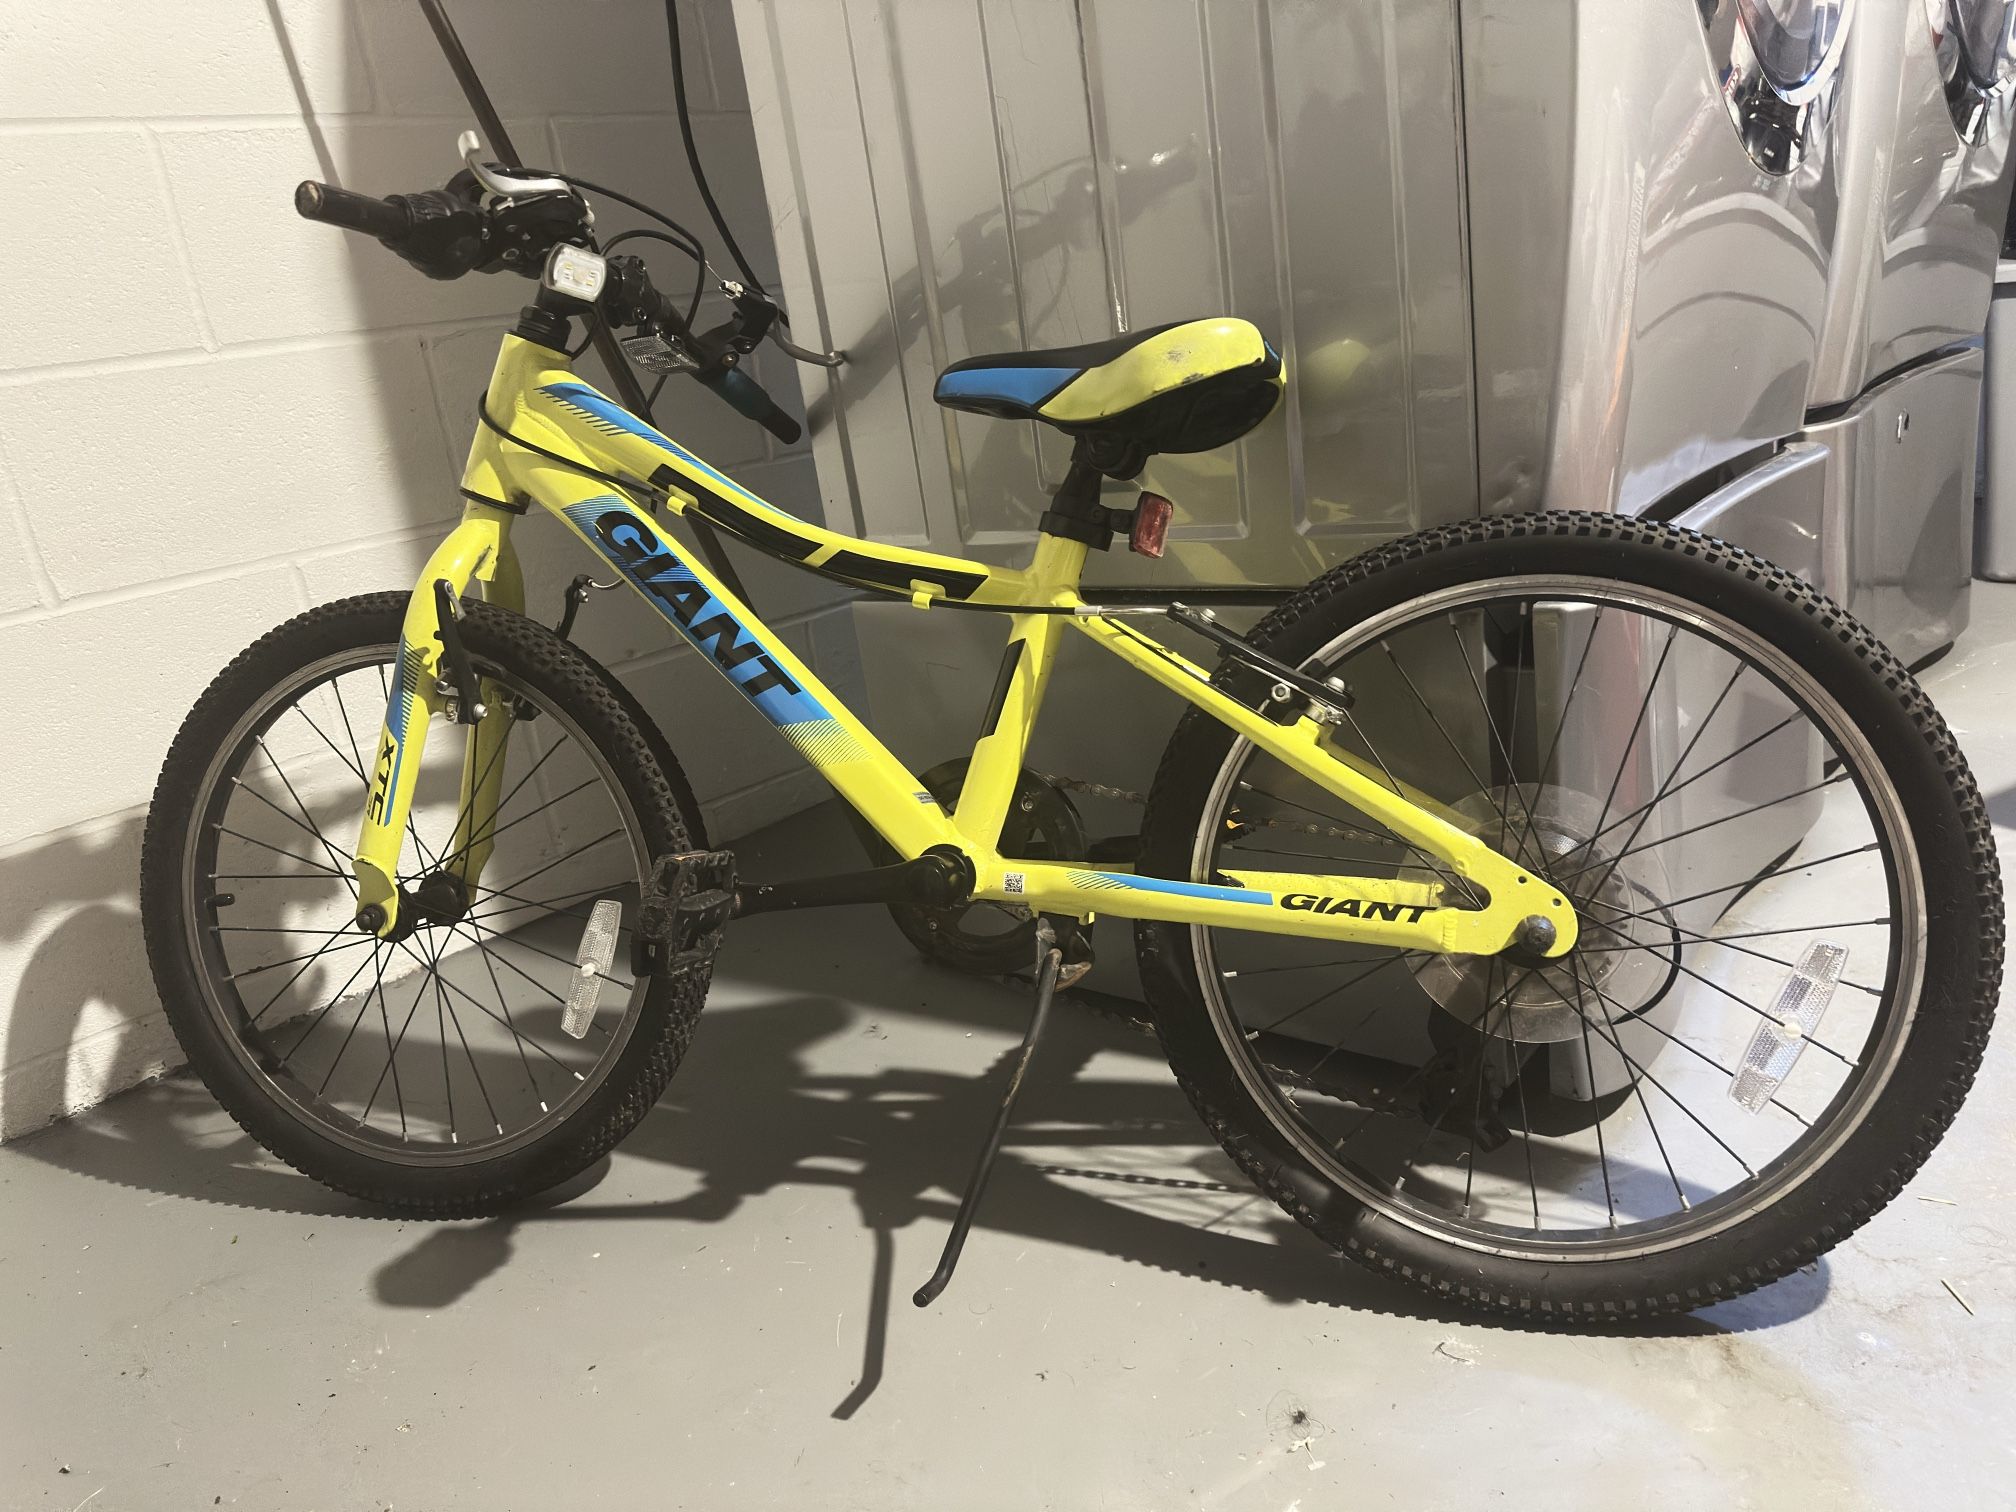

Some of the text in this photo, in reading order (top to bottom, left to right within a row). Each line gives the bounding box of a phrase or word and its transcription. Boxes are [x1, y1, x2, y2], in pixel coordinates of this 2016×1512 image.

[595, 511, 802, 698] GIANT
[370, 735, 395, 826] XTC
[1280, 893, 1438, 924] GIANT
